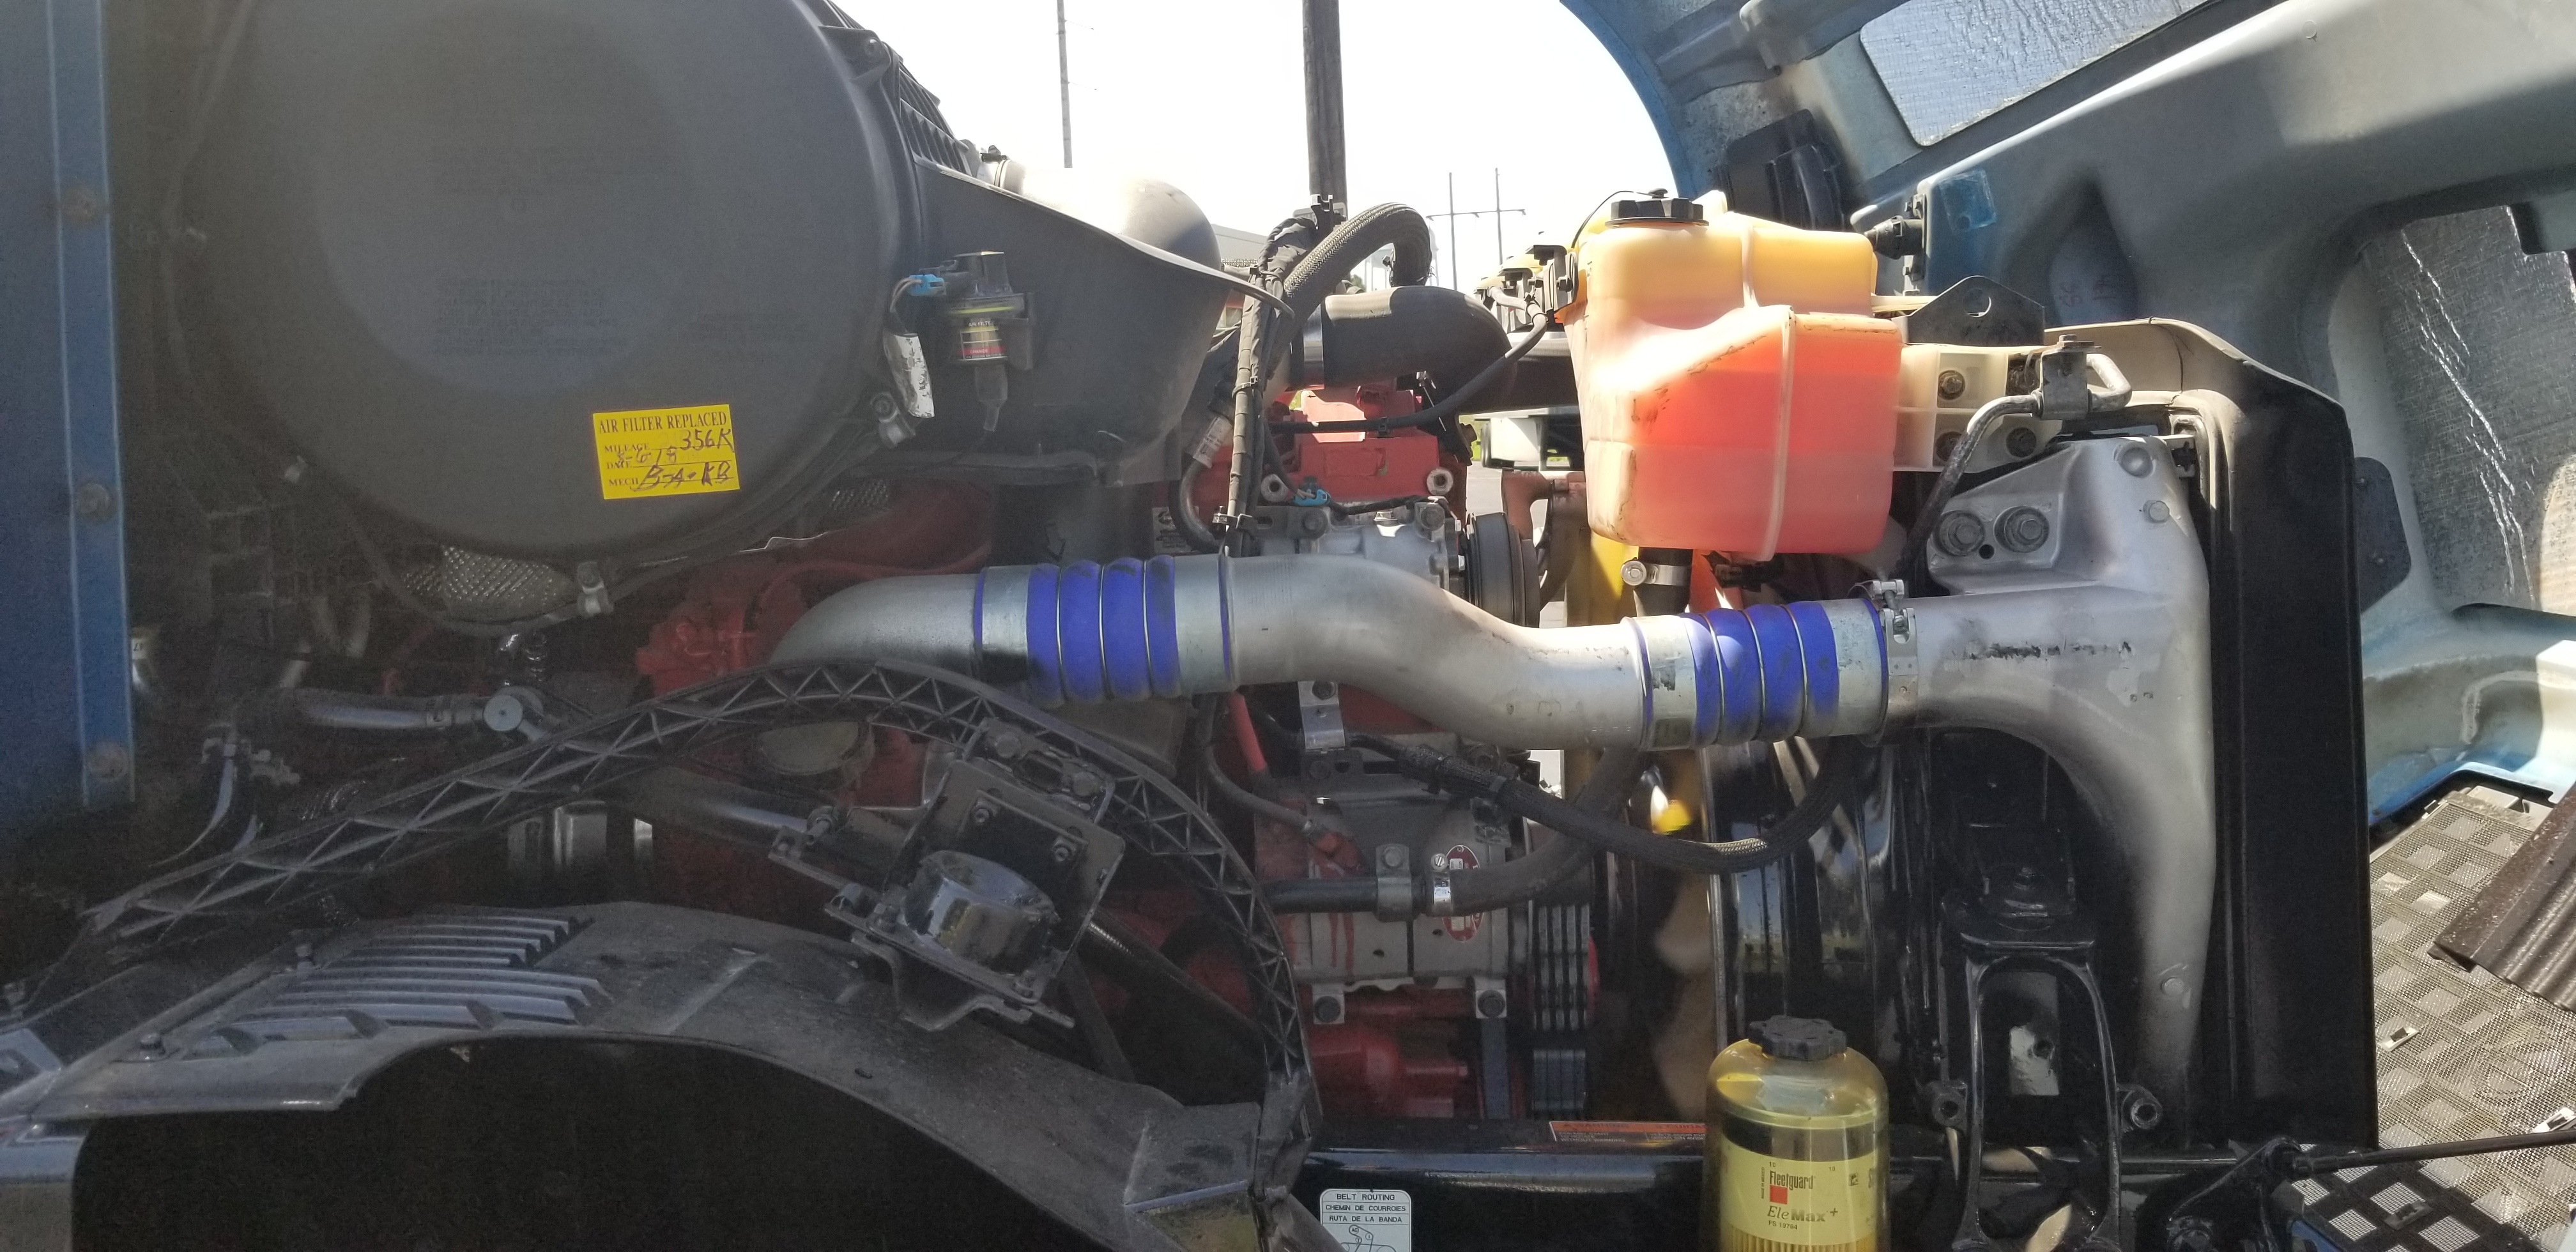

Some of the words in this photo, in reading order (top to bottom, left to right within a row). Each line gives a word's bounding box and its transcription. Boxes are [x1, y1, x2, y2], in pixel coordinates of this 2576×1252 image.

[599, 419, 618, 434] AIR
[623, 416, 663, 432] FILTER
[667, 411, 727, 429] REPLACED
[604, 443, 650, 453] MILEAGE
[607, 461, 631, 470] DATE
[609, 477, 638, 487] MECH
[1769, 1170, 1814, 1191] Fleetguard
